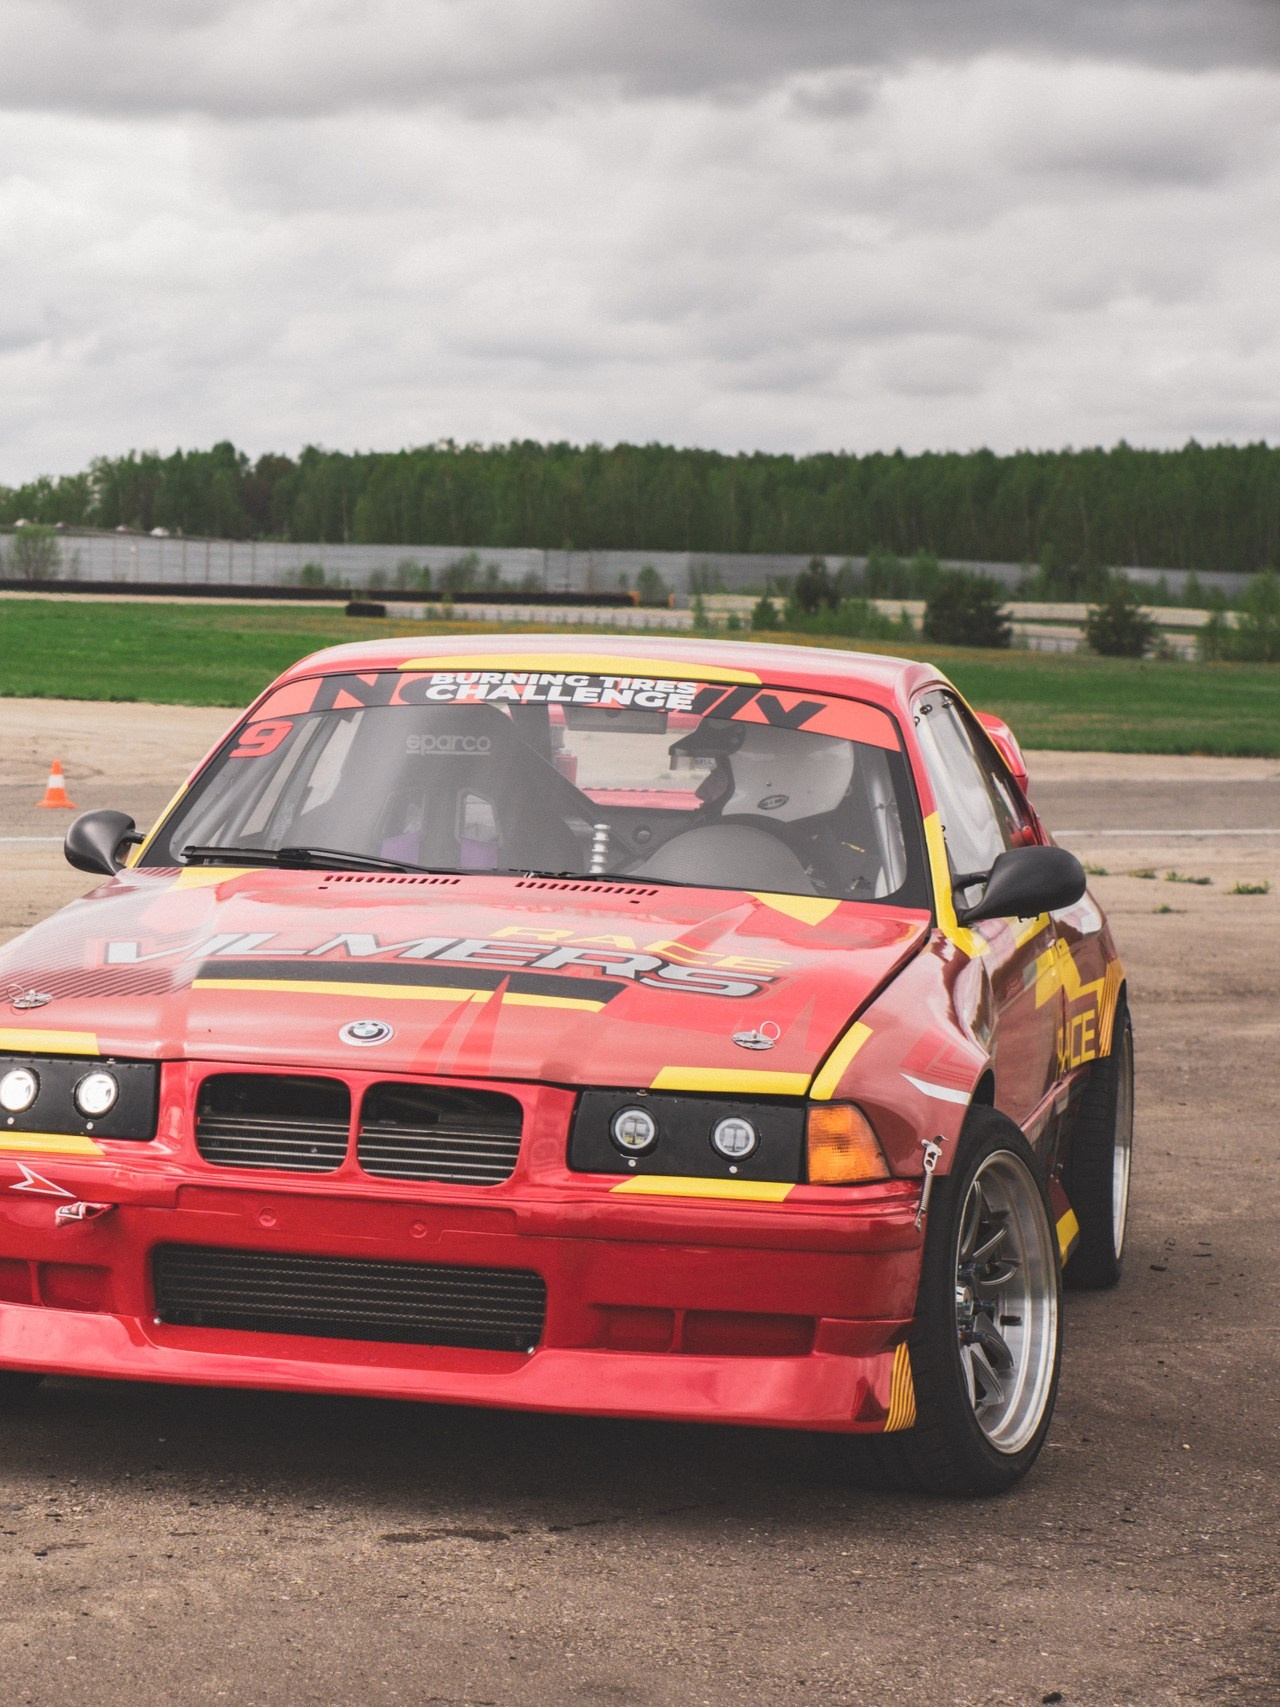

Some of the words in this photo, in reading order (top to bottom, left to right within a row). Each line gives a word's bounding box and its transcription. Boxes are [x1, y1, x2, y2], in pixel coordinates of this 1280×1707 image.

[425, 684, 696, 711] CHALLENGE
[430, 672, 589, 687] BURNING
[600, 676, 697, 694] TIRES
[229, 721, 294, 758] 9
[406, 733, 491, 754] sparco
[104, 932, 780, 998] VILMERS
[488, 925, 793, 973] RACE
